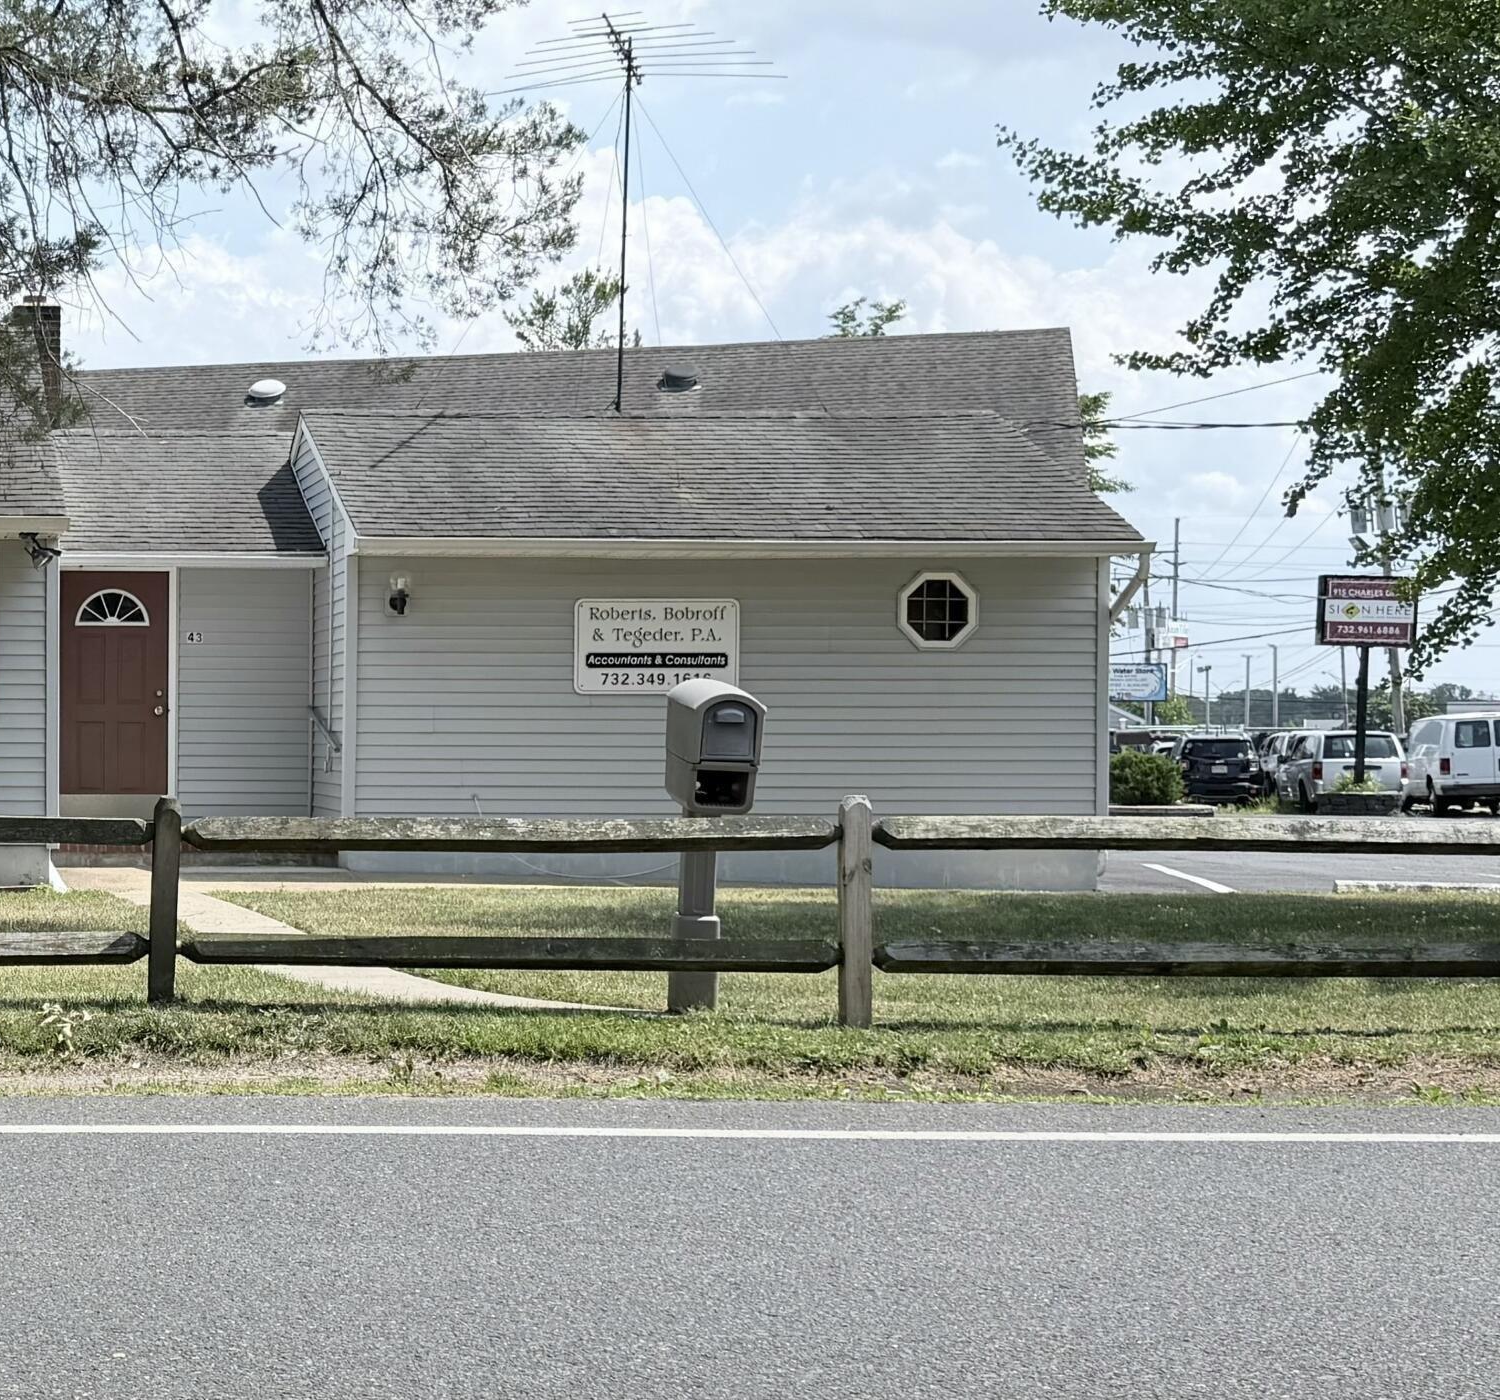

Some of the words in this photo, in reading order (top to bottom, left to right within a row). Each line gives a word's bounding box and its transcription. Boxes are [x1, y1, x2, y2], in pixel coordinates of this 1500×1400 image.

[1348, 588, 1383, 598] CHARLES
[664, 605, 727, 621] Bobroff
[1376, 604, 1412, 616] HERE
[187, 632, 203, 643] 43
[592, 627, 604, 642] &
[691, 628, 722, 642] P.A.
[587, 655, 652, 666] Accountants
[654, 655, 663, 666] &
[665, 655, 726, 666] Consultants
